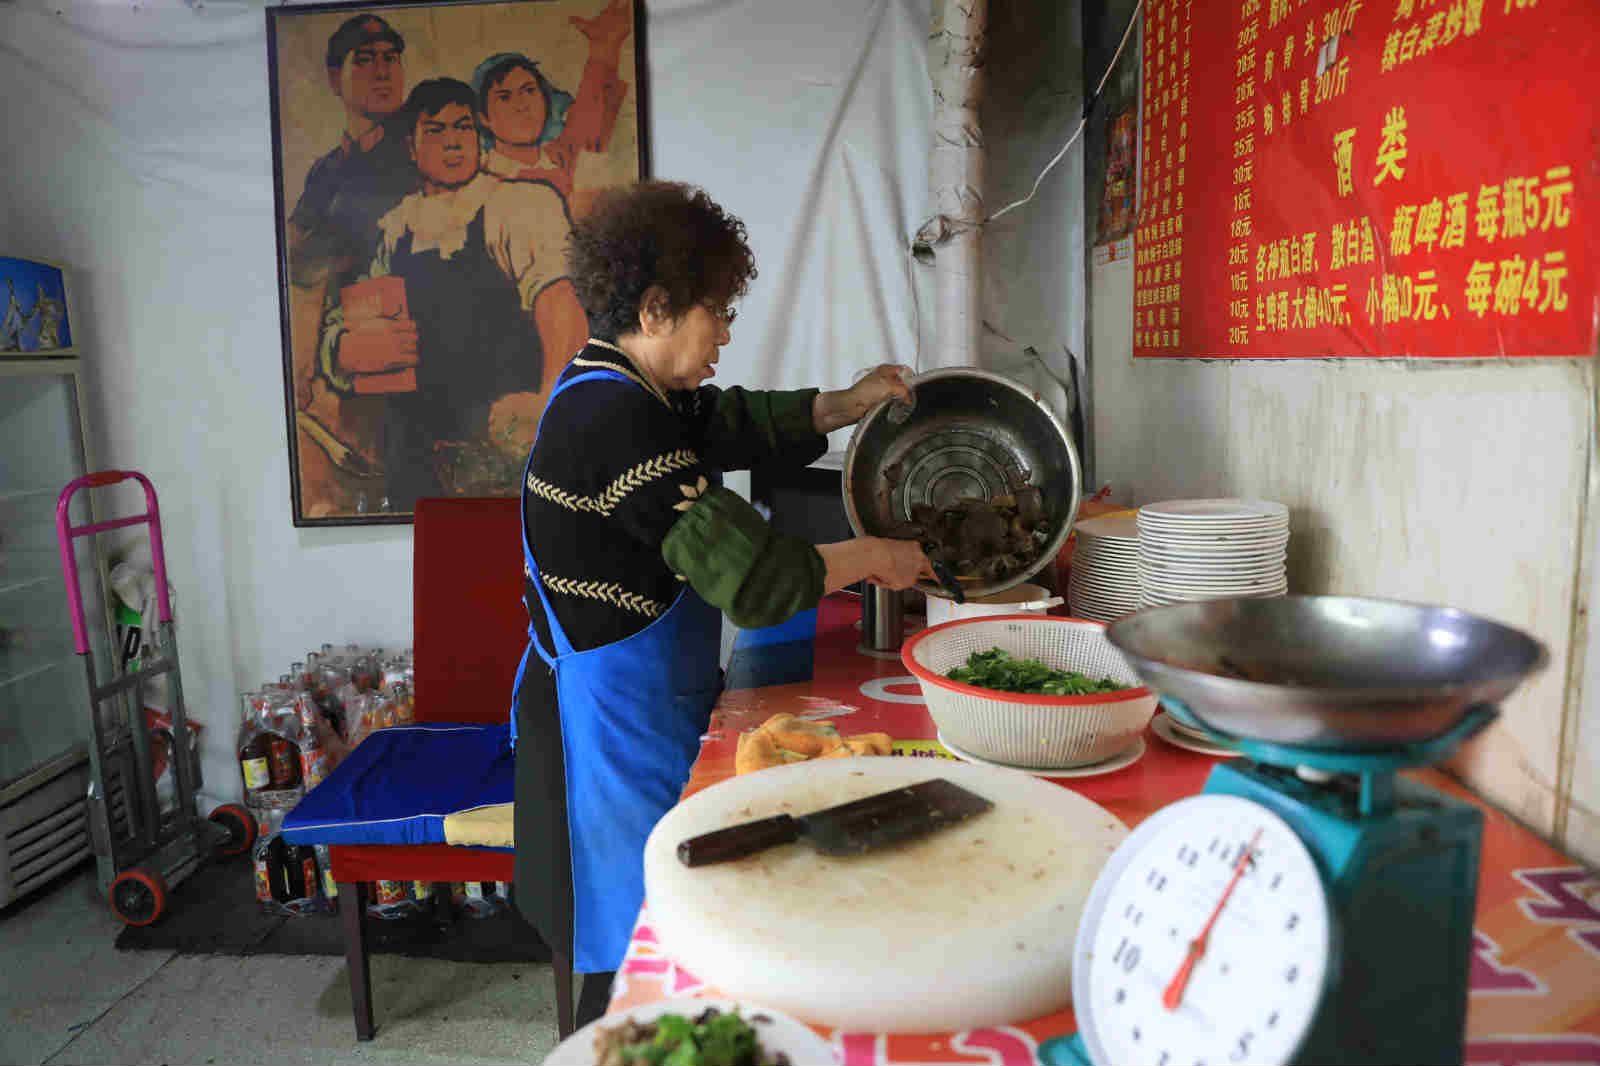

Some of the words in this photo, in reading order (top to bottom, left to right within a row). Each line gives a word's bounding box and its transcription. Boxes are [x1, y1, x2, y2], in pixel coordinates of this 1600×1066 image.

[1333, 105, 1408, 197] 酒类
[1475, 166, 1573, 243] 每瓶5元
[1465, 251, 1568, 319] 每碗4元
[1113, 937, 1141, 974] 10
[1229, 1031, 1255, 1062] 5
